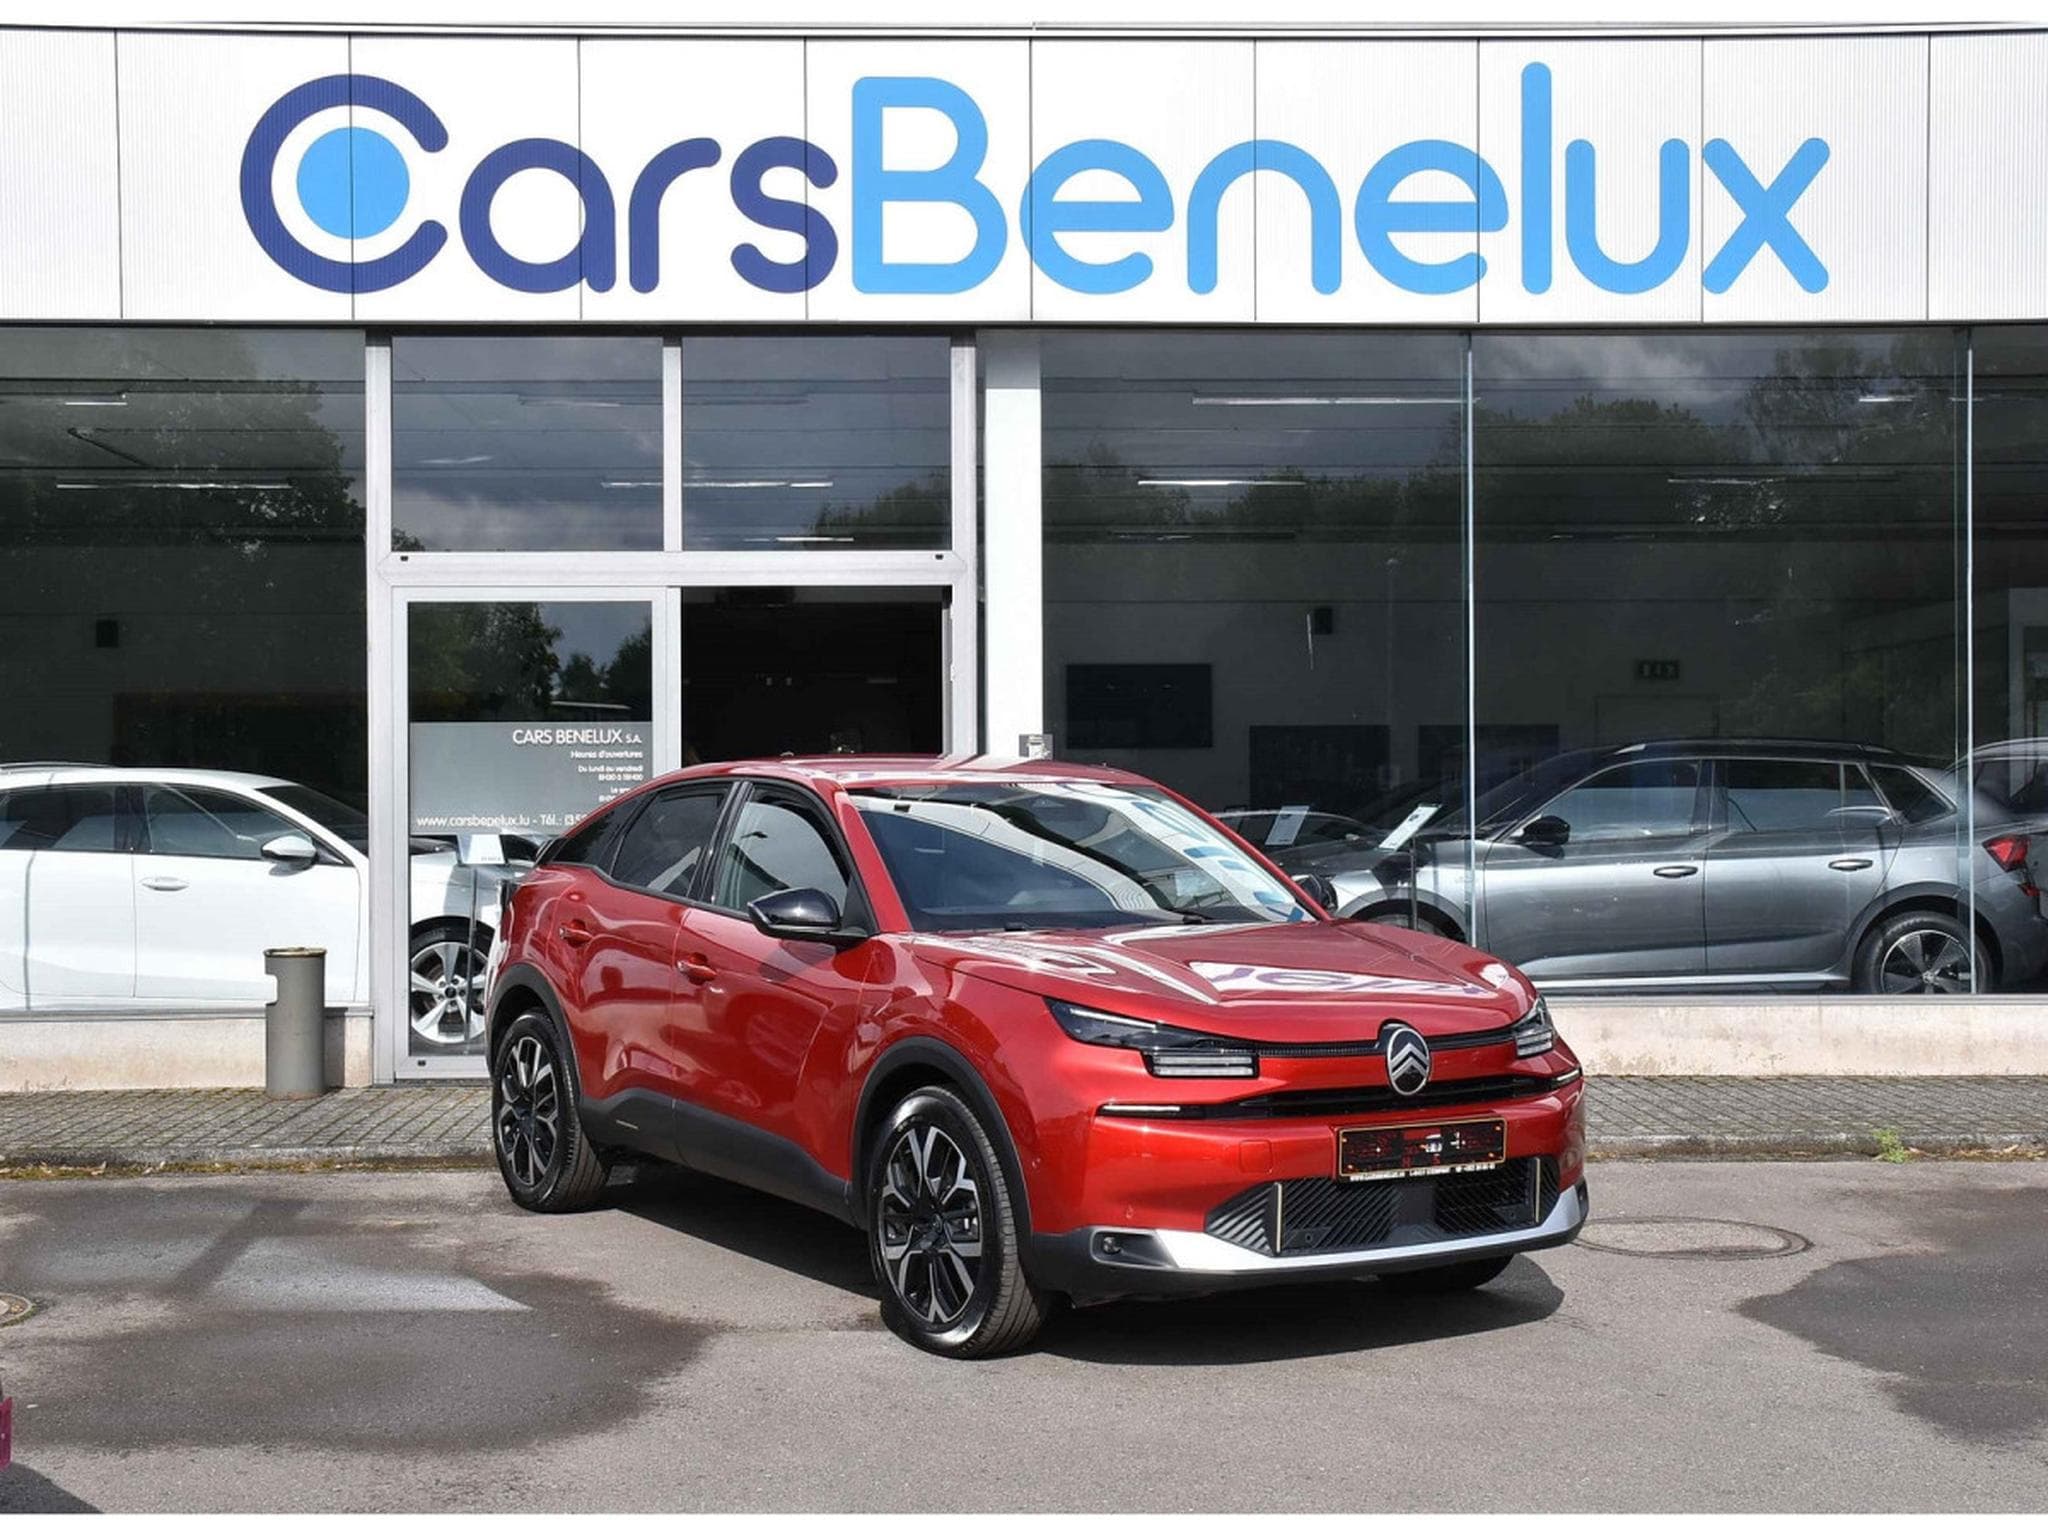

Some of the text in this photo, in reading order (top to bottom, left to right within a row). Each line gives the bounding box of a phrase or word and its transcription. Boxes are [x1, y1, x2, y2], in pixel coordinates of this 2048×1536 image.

[241, 64, 1829, 294] CarsBenelux
[512, 729, 553, 745] CARS
[555, 729, 623, 745] BENELUX
